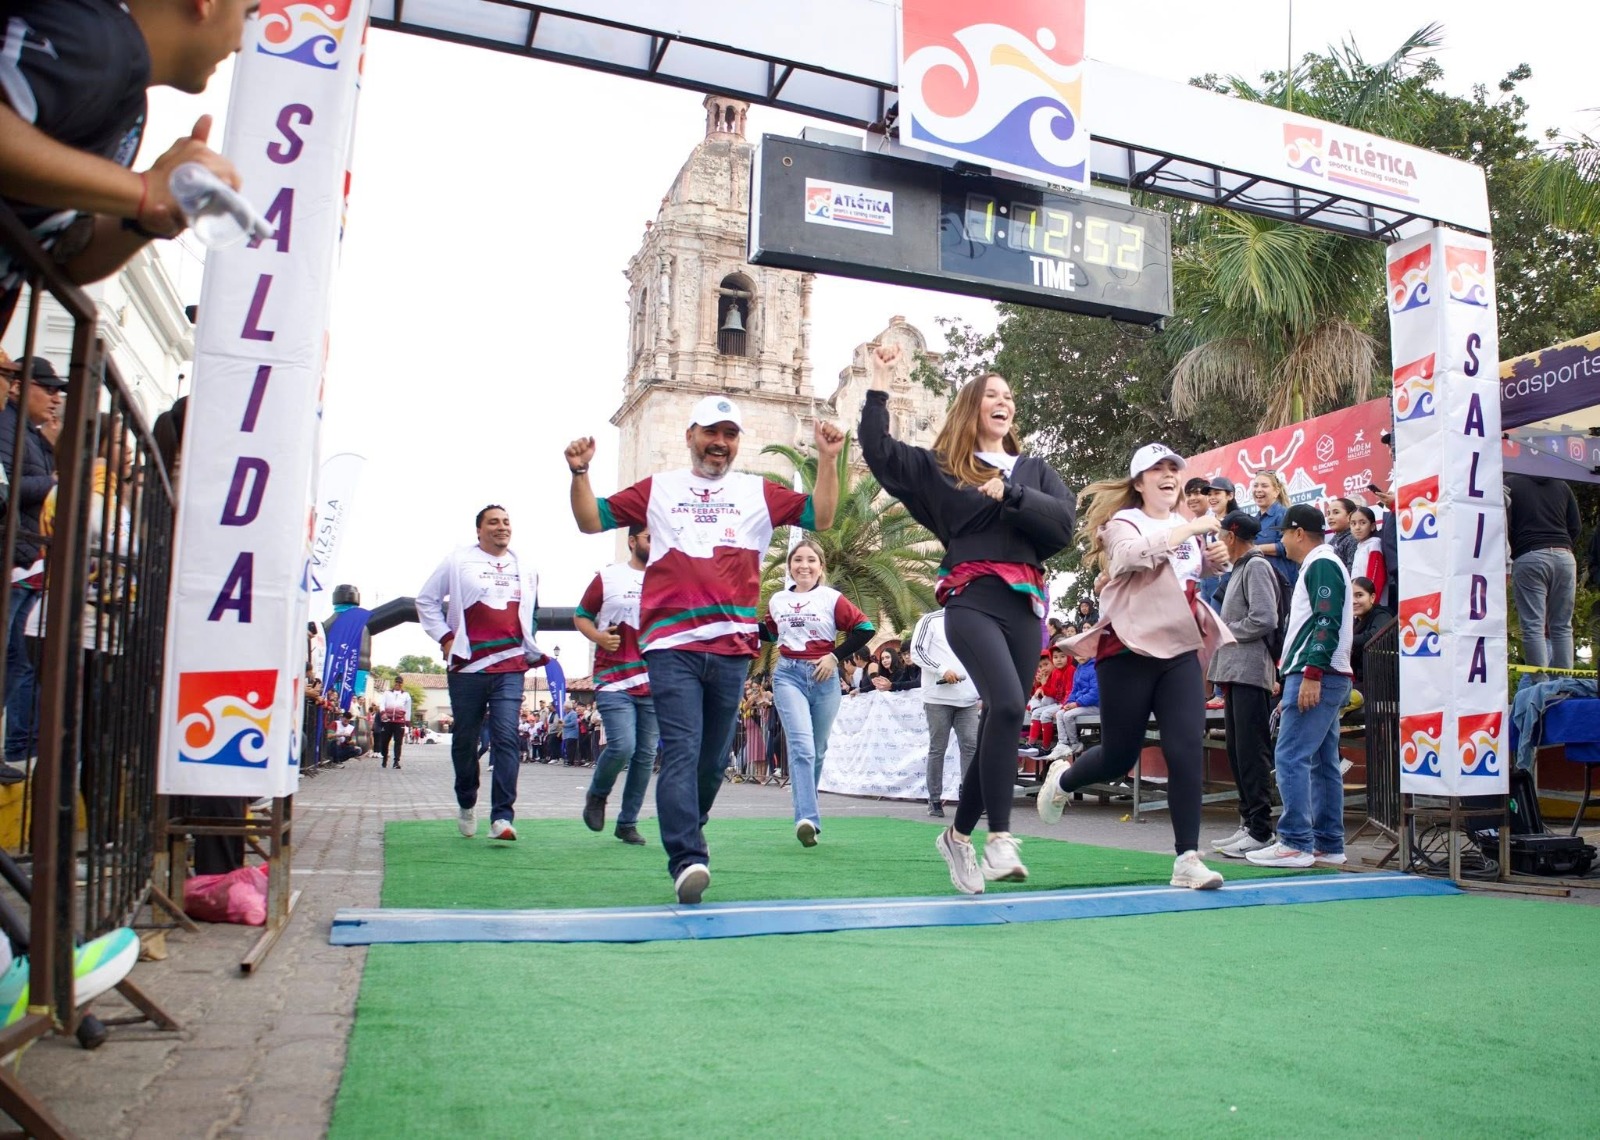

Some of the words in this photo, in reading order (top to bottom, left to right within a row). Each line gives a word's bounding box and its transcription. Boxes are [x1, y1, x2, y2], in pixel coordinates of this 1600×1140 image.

[1328, 160, 1352, 172] sports
[1360, 168, 1383, 181] timing
[1384, 175, 1409, 187] system
[983, 201, 1142, 270] 1:12:52
[1029, 256, 1076, 292] TIME
[208, 103, 314, 623] SALIDA
[1348, 442, 1371, 453] IMDEM
[692, 507, 741, 516] SEBASTIAN
[1291, 492, 1312, 503] ATÓN
[1463, 332, 1488, 684] SALIDA
[312, 500, 339, 566] VIZSLA
[694, 514, 718, 523] 2026
